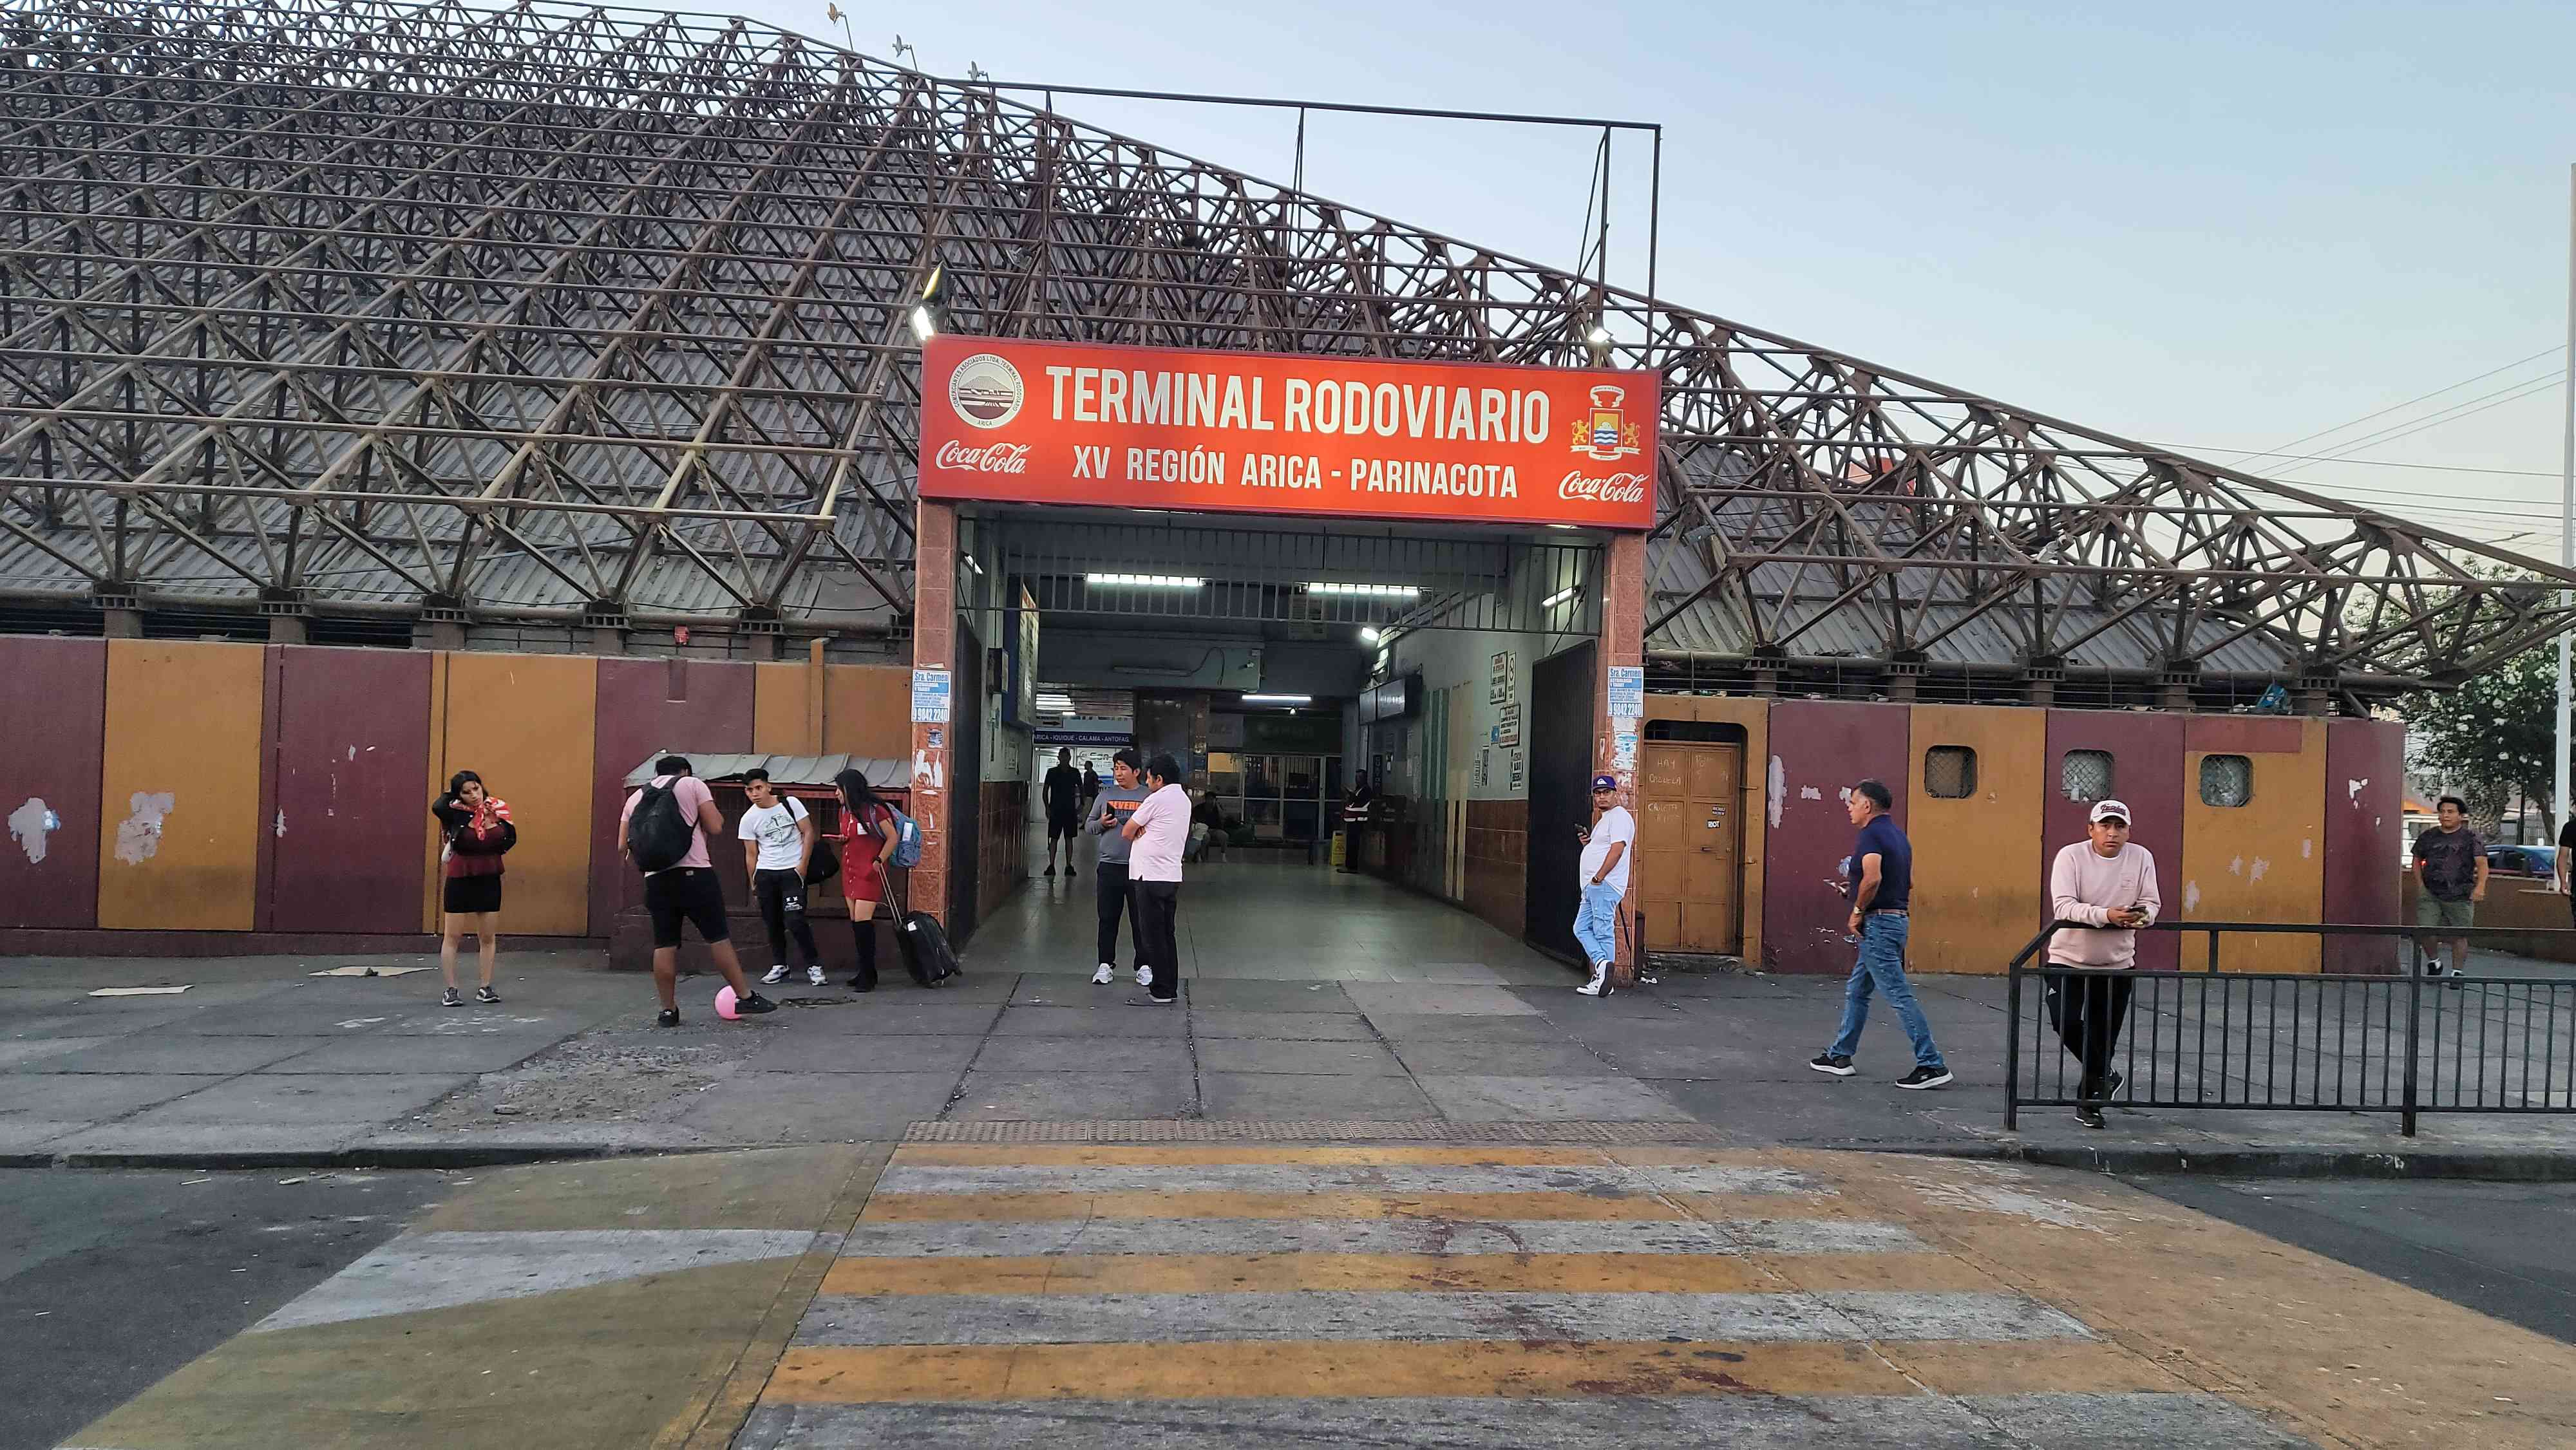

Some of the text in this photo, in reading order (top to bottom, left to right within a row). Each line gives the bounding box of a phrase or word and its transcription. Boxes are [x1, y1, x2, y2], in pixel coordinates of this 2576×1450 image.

[960, 355, 986, 372] ASOCIADOS
[1045, 366, 1550, 444] TERMINAL RODOVIARIO
[936, 440, 1032, 473] Coca-Cola
[1072, 445, 1111, 478] XV
[1126, 444, 1225, 484] REGIÓN
[1241, 453, 1322, 490] ARICA
[1350, 458, 1518, 498] PARINACOTA
[1558, 471, 1649, 502] Coca-Cola
[927, 672, 948, 682] Carmen
[1621, 668, 1642, 677] Carmen
